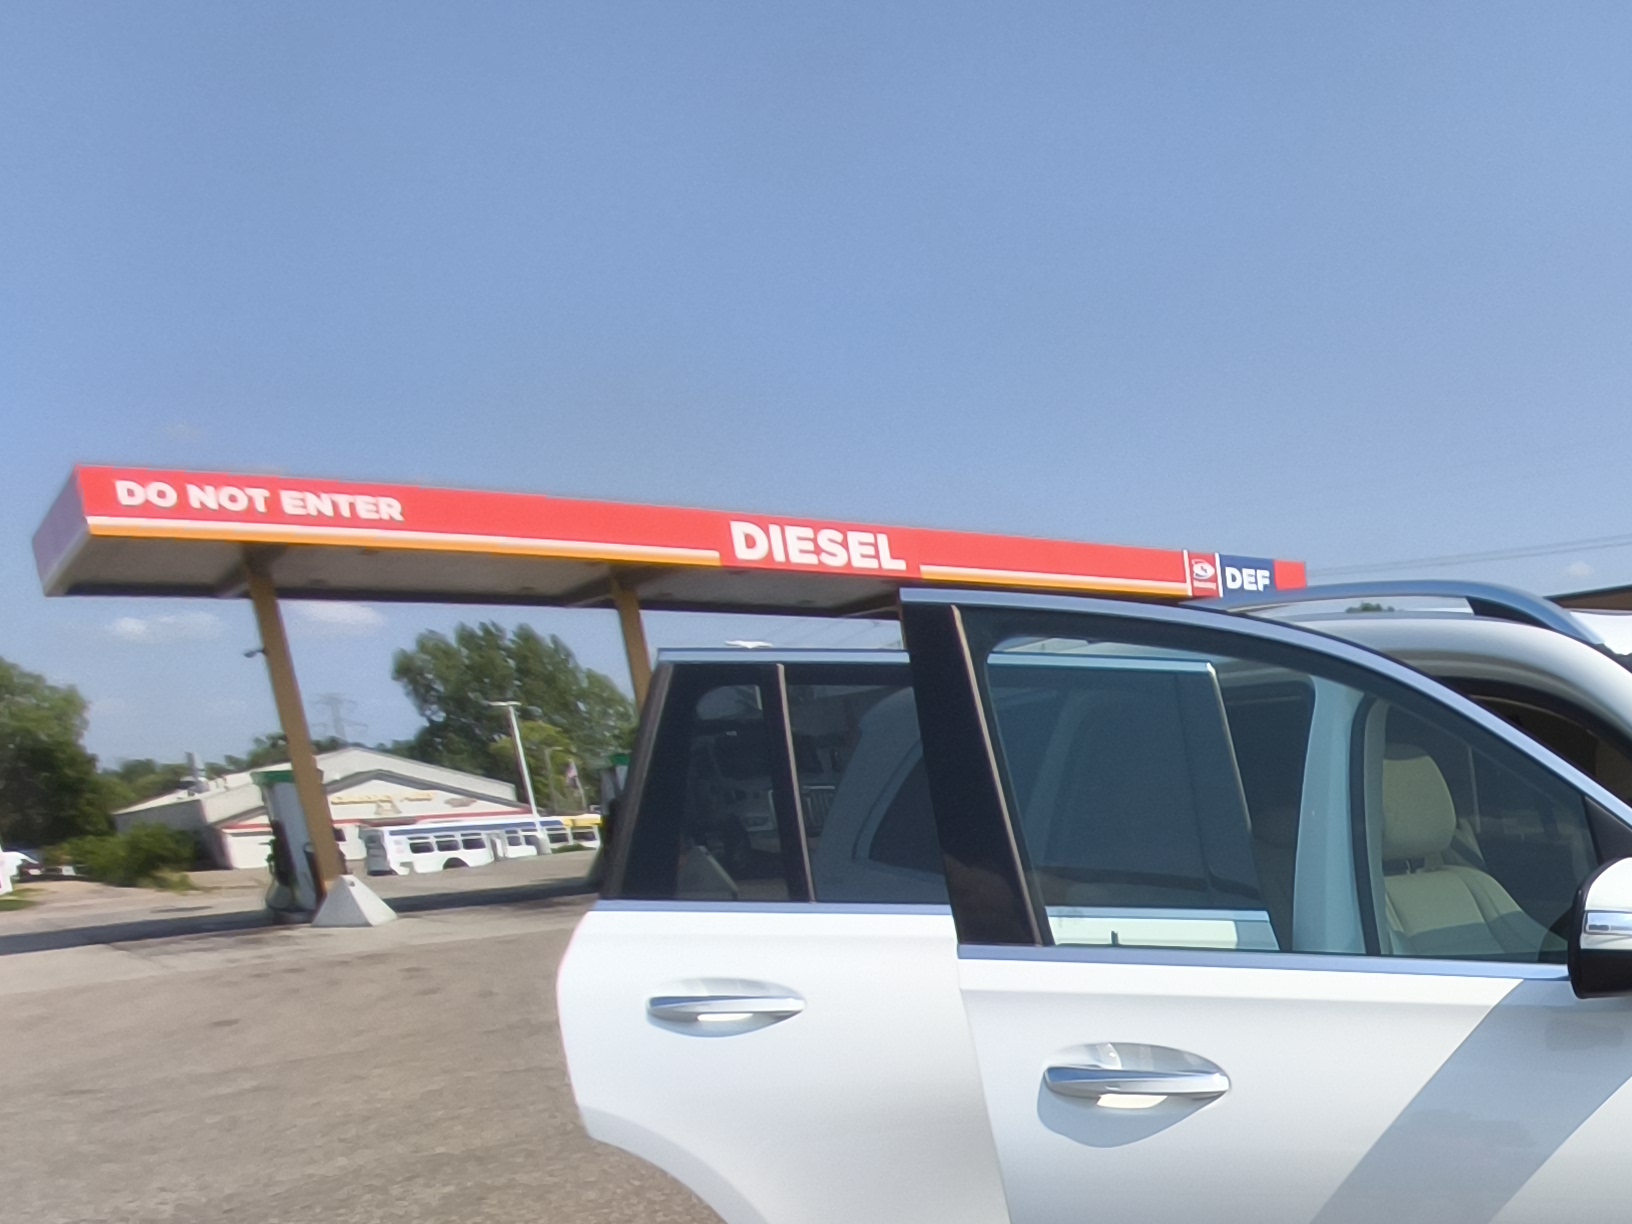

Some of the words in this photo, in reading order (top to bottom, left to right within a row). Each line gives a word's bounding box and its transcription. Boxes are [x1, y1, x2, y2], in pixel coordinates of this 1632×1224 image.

[115, 480, 178, 509] DO
[185, 484, 270, 513] NOT
[279, 489, 404, 521] ENTER
[730, 520, 907, 571] DIESEL
[1225, 566, 1271, 592] DEF
